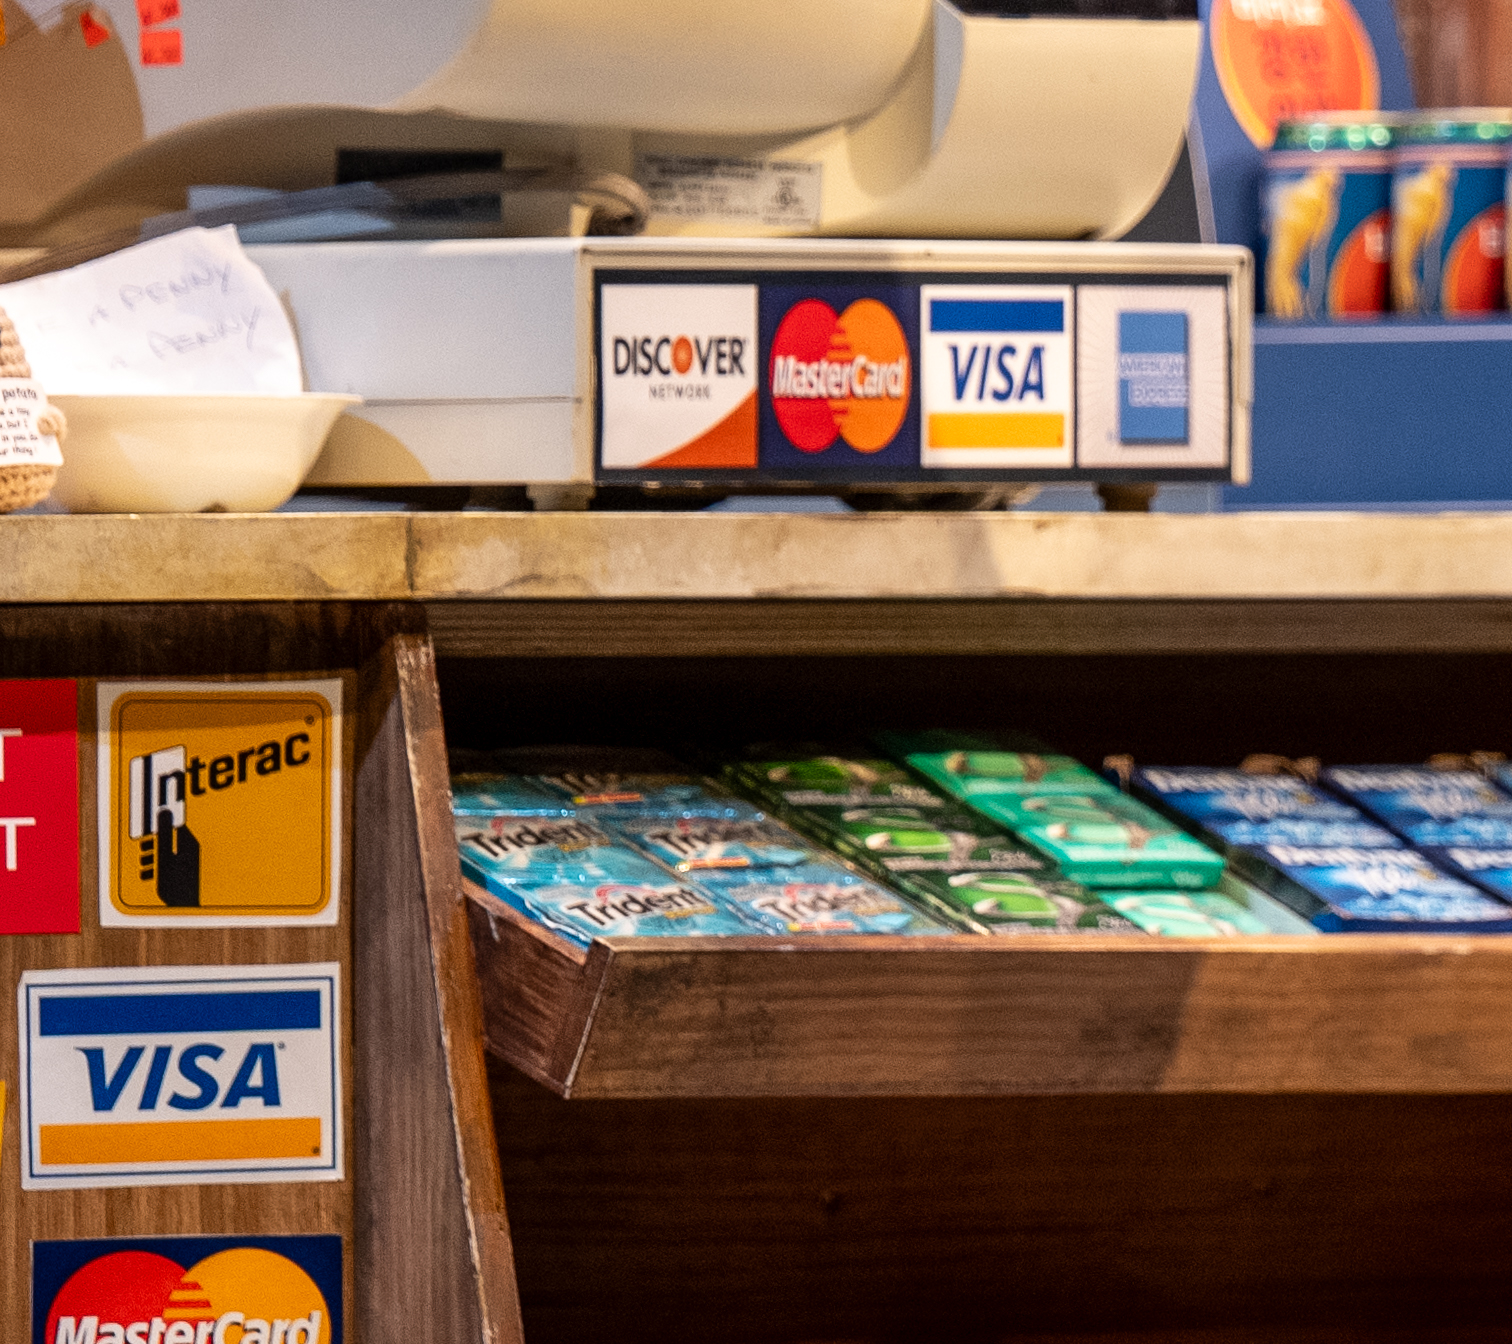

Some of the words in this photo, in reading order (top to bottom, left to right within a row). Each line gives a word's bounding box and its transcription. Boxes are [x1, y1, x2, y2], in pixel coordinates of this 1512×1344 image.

[613, 334, 747, 378] DISCOVER
[772, 353, 905, 400] MasterCard
[948, 342, 1046, 402] VISA
[648, 383, 711, 401] NETWORK
[567, 885, 705, 926] Trident
[74, 1042, 282, 1112] VISA
[54, 1309, 322, 1344] MasterCard
